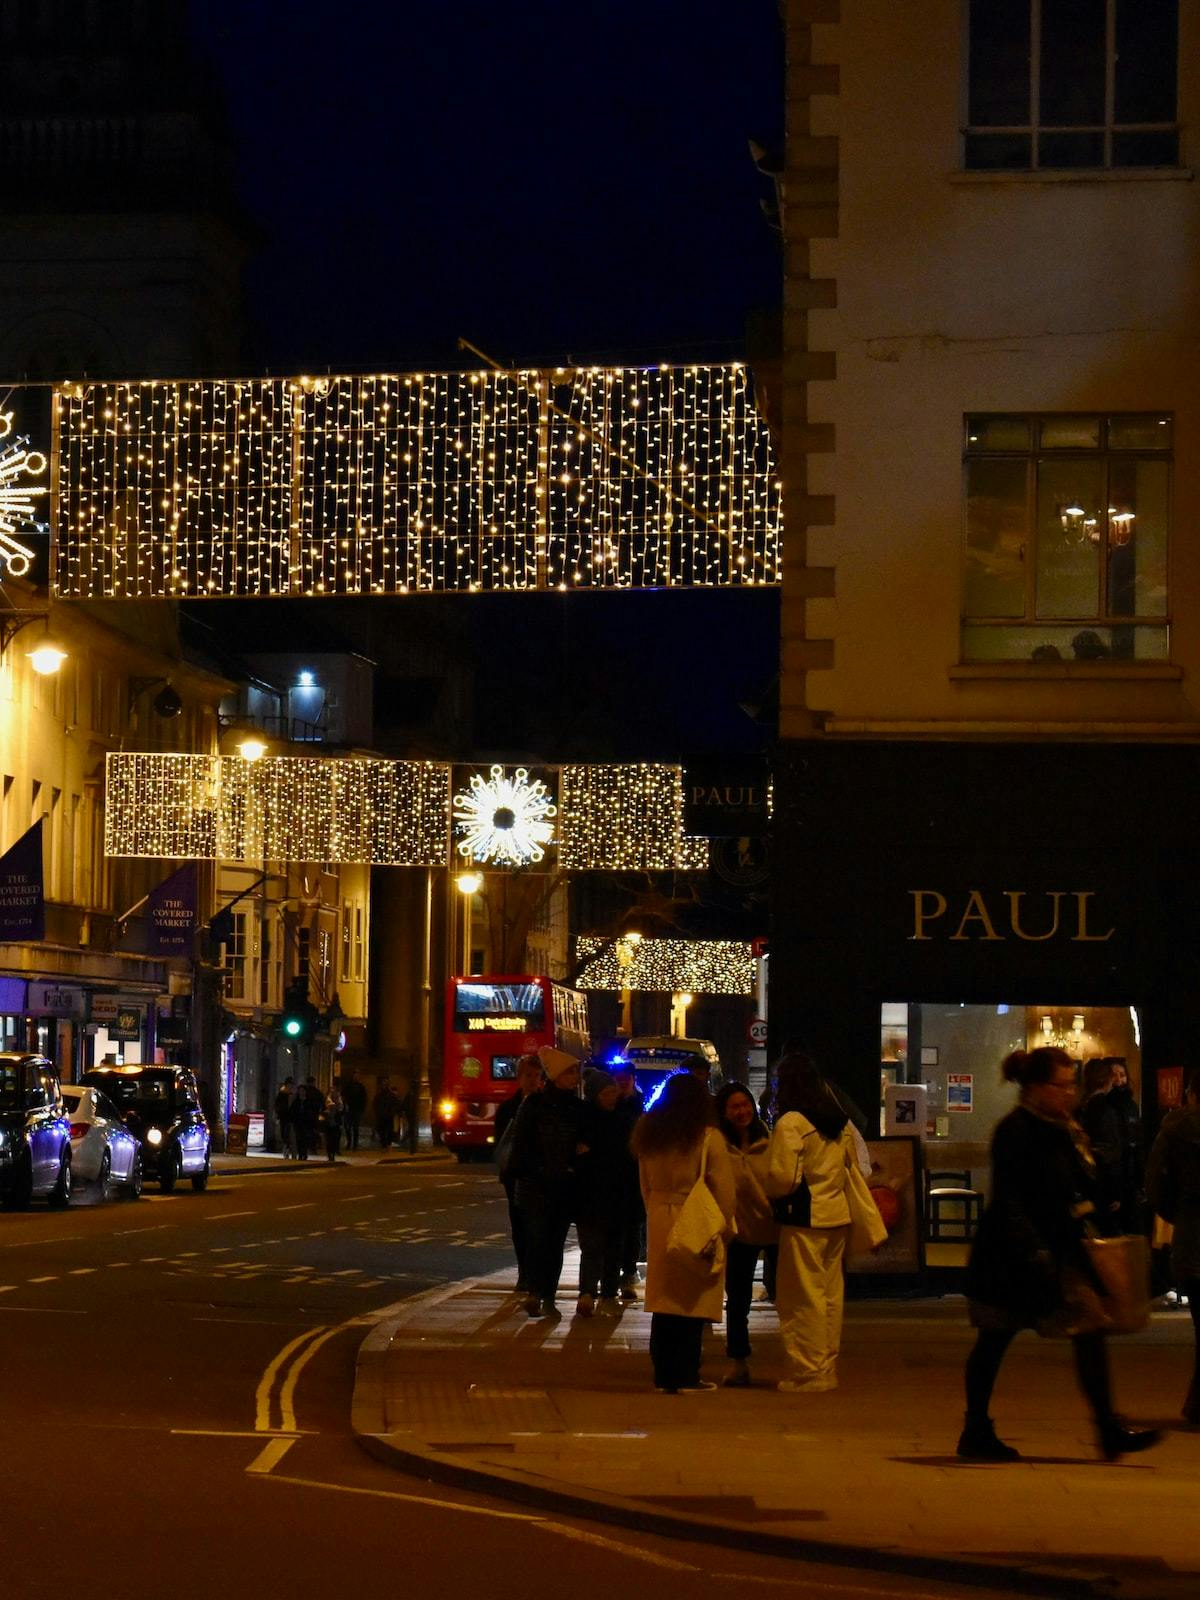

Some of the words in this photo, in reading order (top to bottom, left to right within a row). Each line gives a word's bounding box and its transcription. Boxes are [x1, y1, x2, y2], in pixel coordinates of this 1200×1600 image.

[691, 786, 761, 806] PAUL
[7, 874, 28, 884] THE
[164, 899, 183, 908] THE
[152, 909, 194, 918] COVERED
[906, 889, 1117, 942] PAUL
[154, 918, 192, 927] MARKET
[752, 1026, 768, 1037] 20
